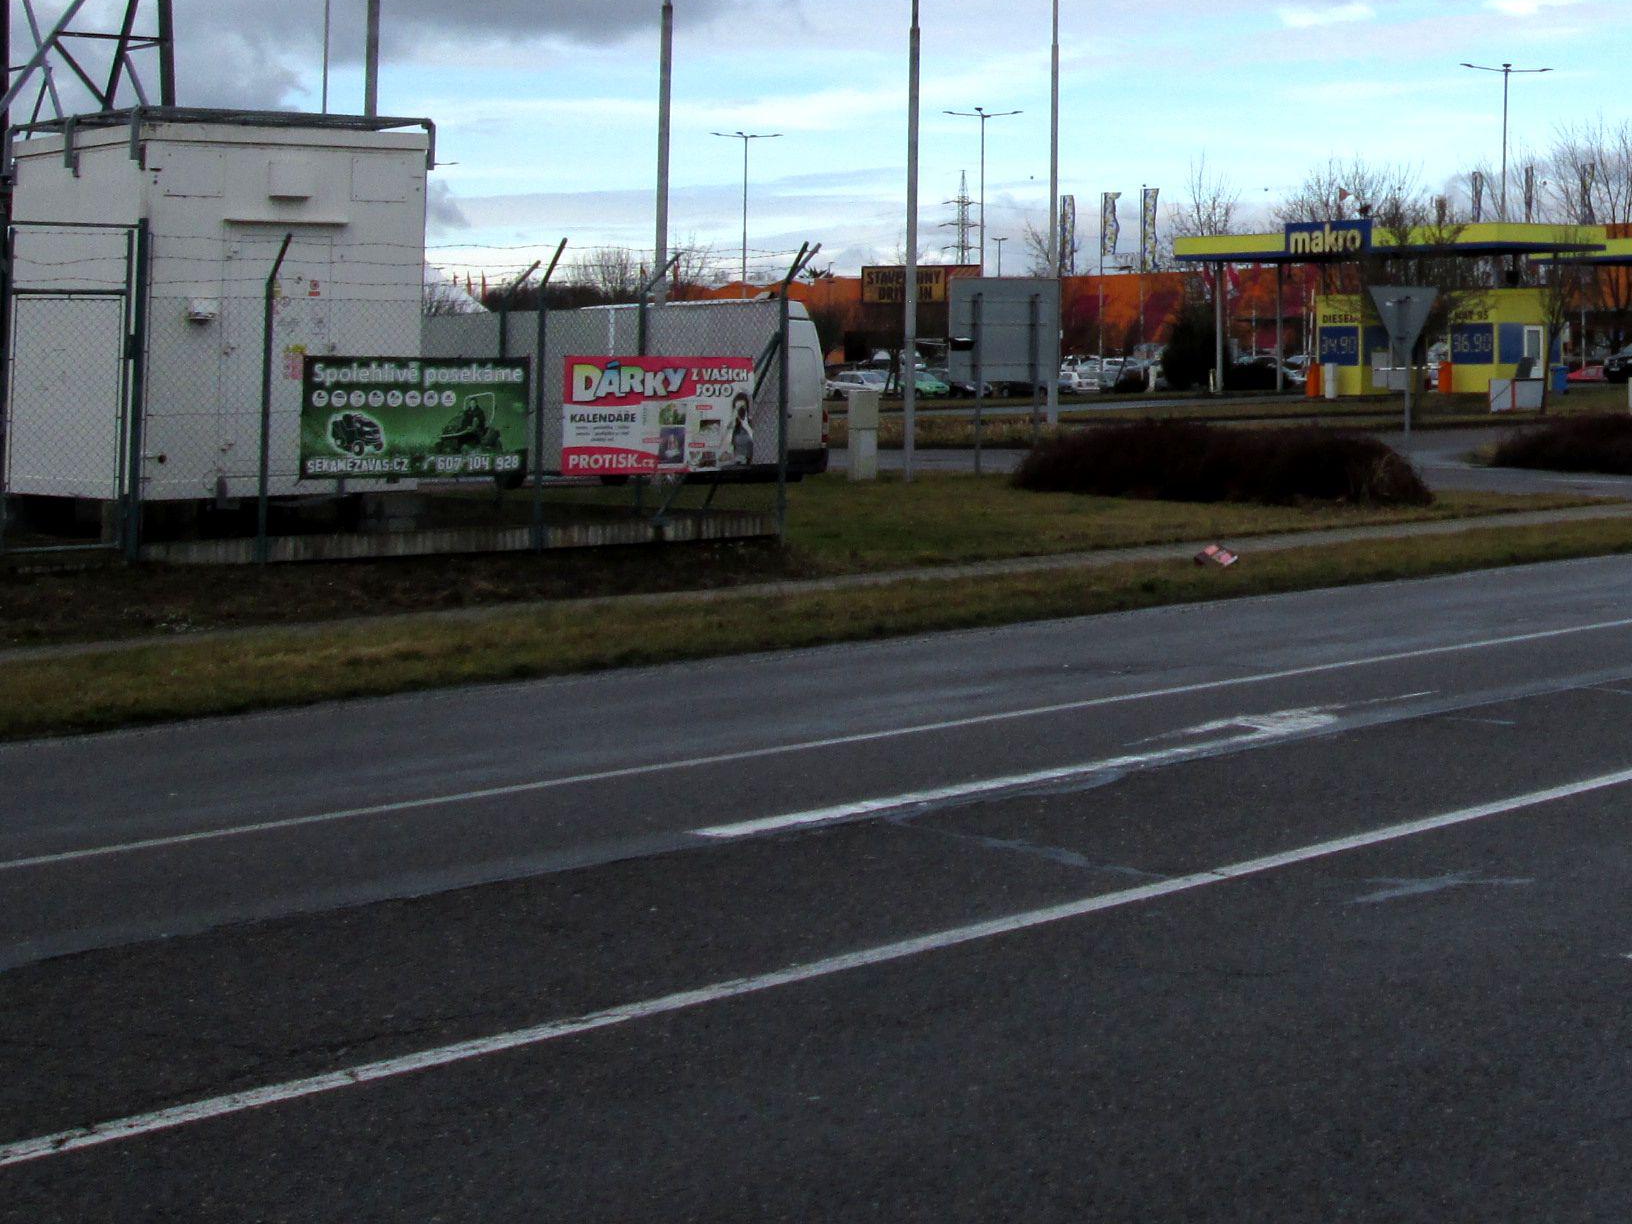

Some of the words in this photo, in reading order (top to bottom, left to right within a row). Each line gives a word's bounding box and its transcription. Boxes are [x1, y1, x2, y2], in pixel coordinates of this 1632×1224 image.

[1289, 223, 1361, 254] makro
[313, 361, 420, 387] Spolehlivě
[423, 362, 524, 388] posekáme
[691, 369, 698, 381] Z
[702, 365, 748, 382] VAŠICH
[697, 383, 735, 398] FOTO
[570, 411, 636, 424] KALENDÁŘE
[435, 456, 463, 471] 607
[468, 456, 489, 470] 104
[495, 455, 520, 469] 928
